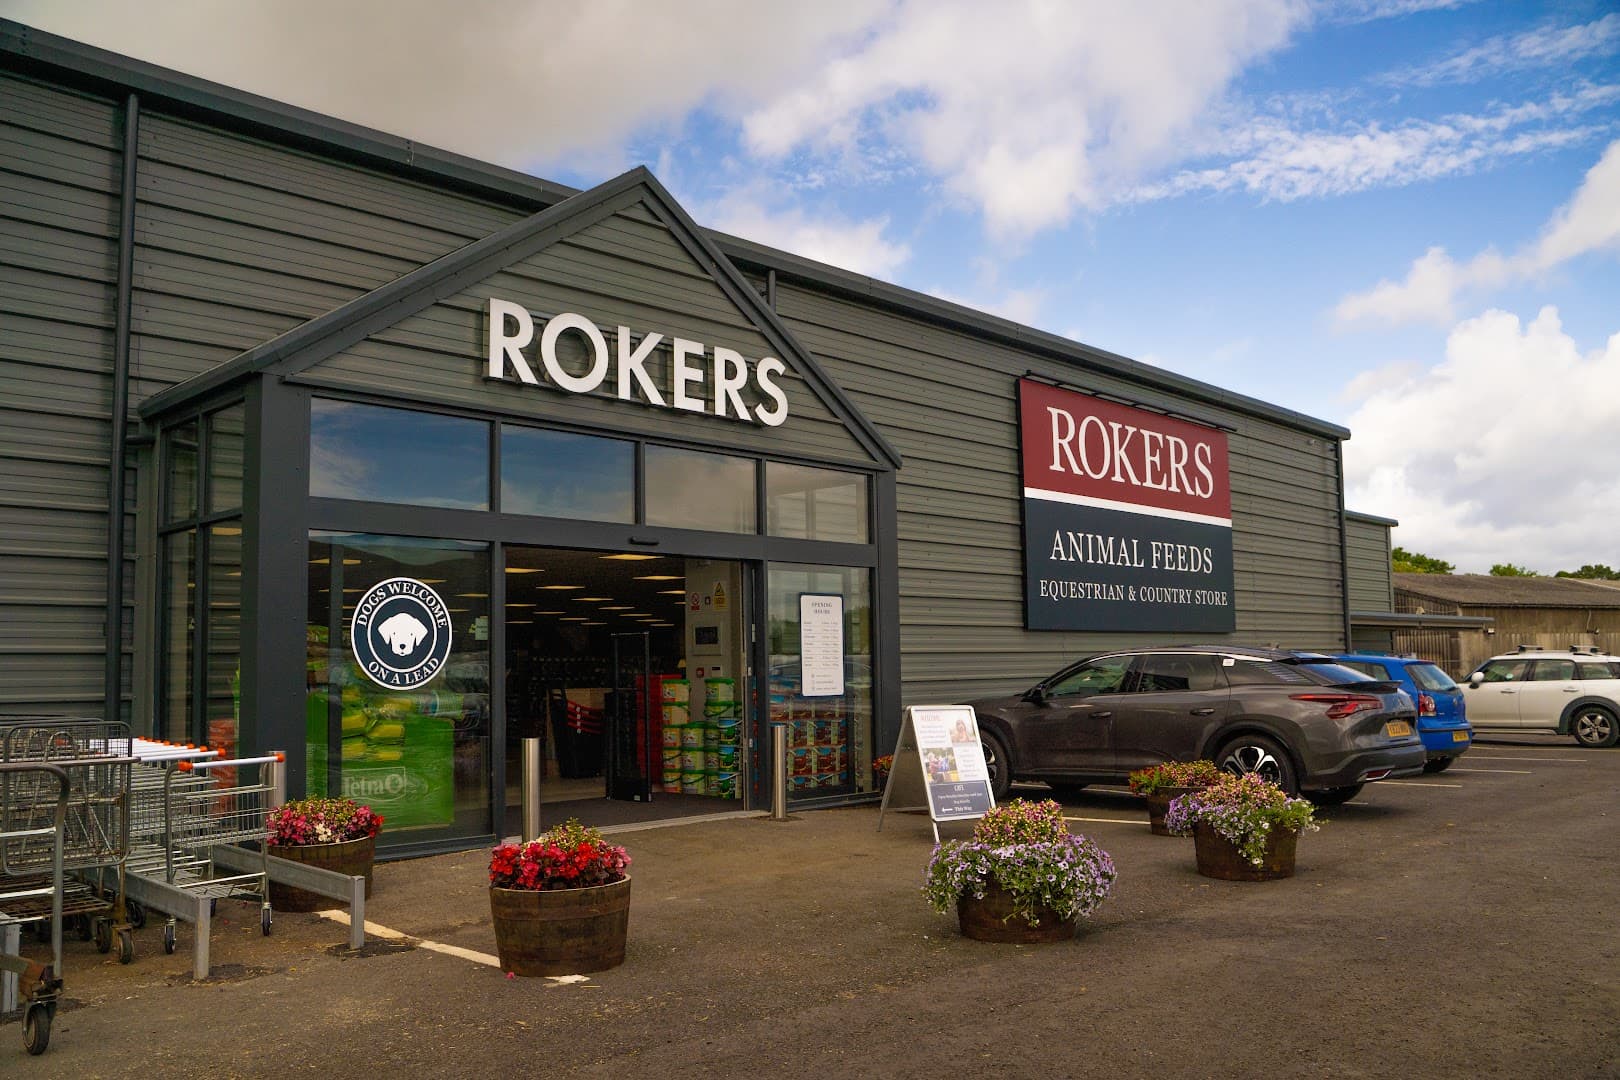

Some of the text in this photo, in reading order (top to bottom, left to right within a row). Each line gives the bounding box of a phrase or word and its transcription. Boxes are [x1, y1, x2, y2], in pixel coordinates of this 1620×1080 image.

[488, 297, 789, 427] ROKERS
[1047, 406, 1214, 499] ROKERS
[1050, 529, 1213, 574] ANIMAL FEEDS
[356, 582, 448, 628] DOGS WELCOME
[1040, 579, 1228, 606] EQUESTRIAN & COUNTRY STORE
[368, 657, 440, 684] ON A LEAD
